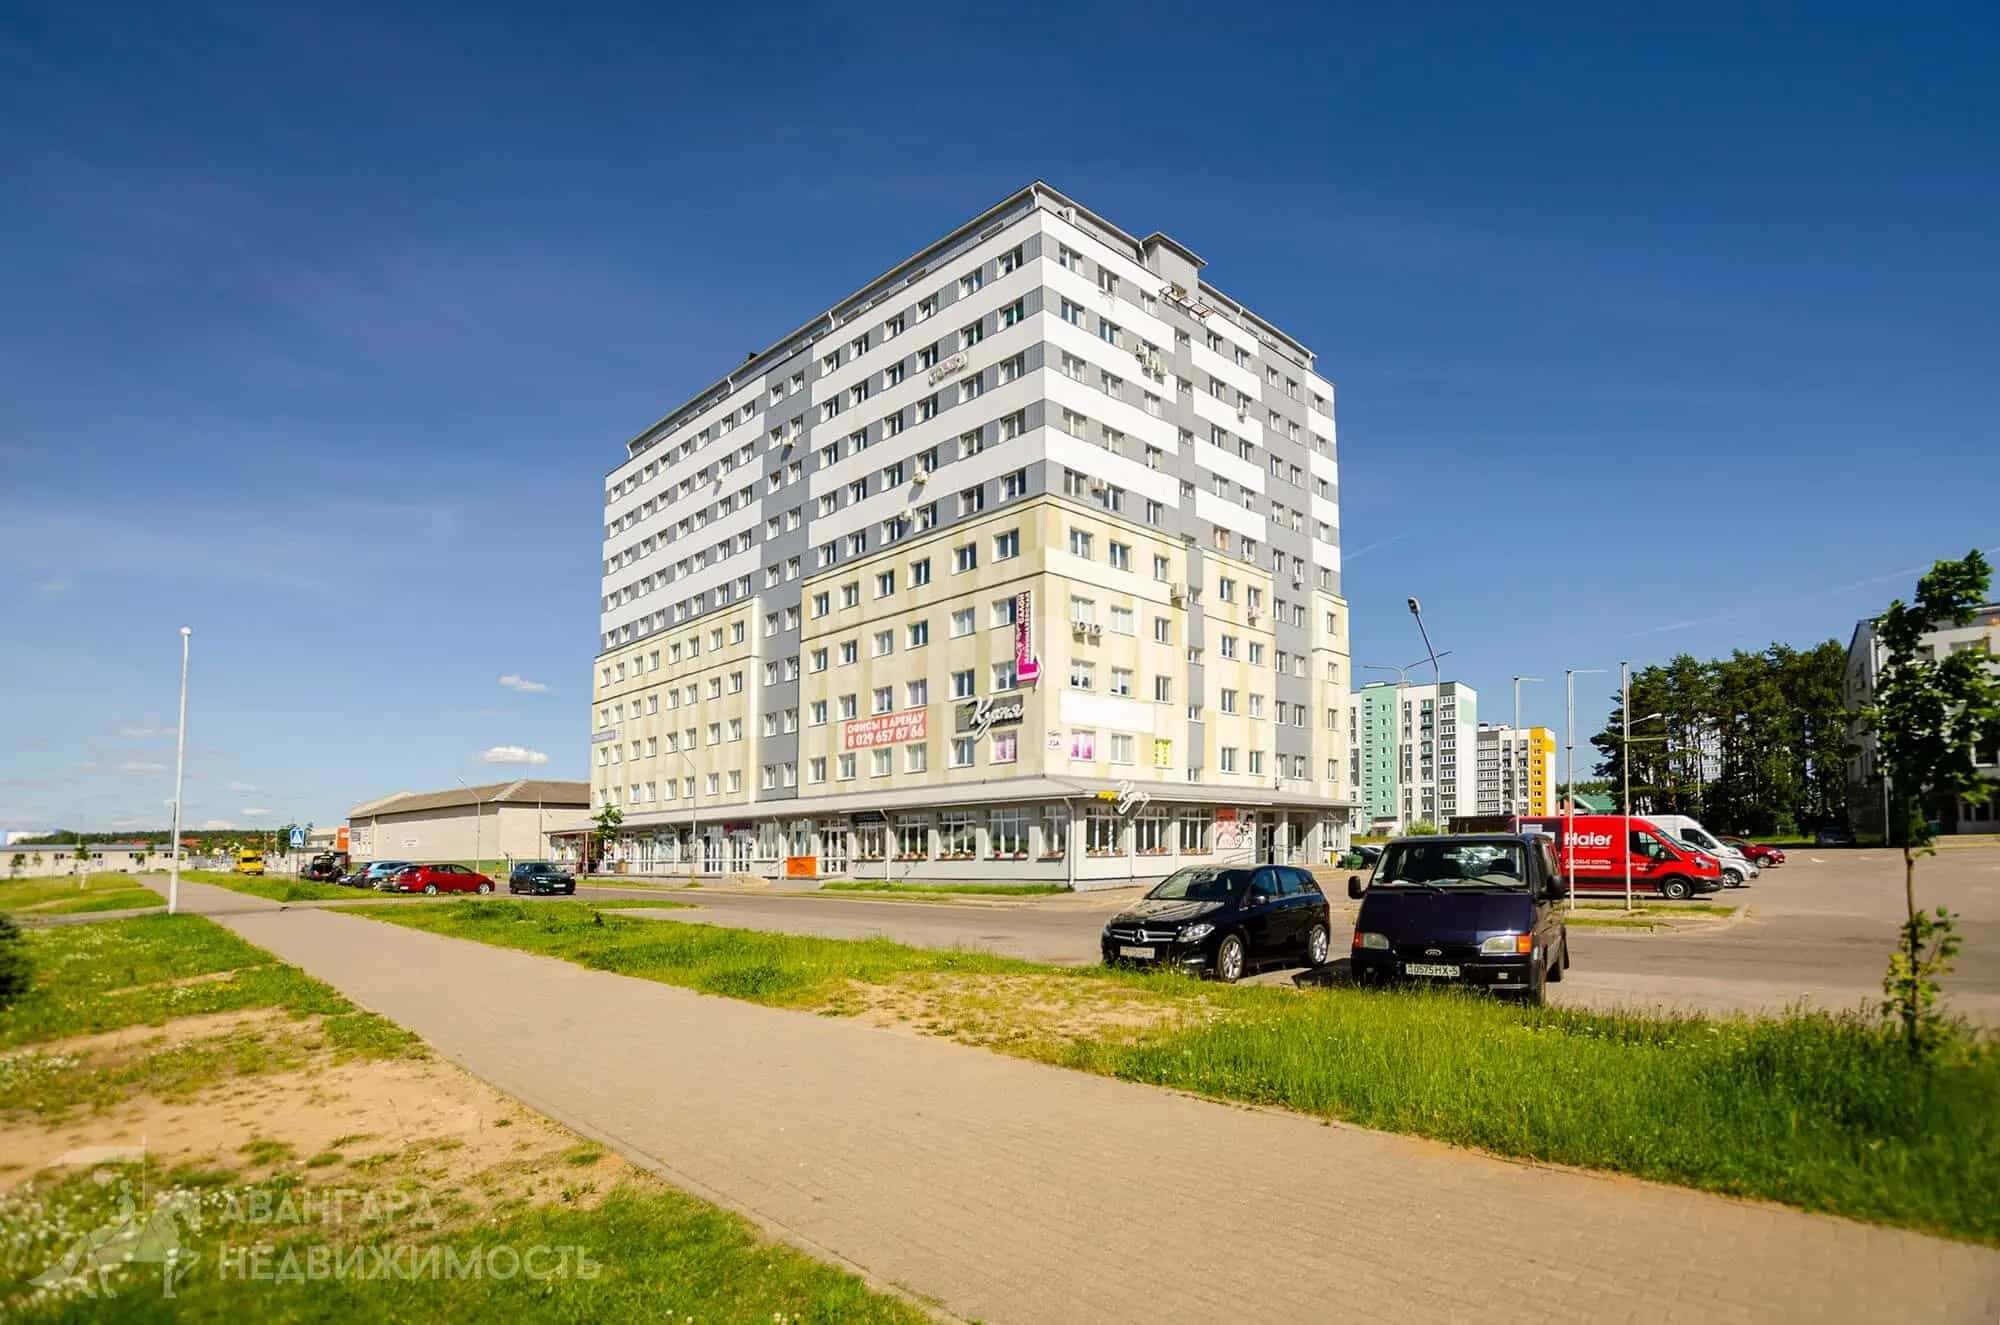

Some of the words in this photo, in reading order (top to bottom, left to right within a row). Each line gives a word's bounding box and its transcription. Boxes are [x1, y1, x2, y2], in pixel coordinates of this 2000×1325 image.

[847, 719, 880, 734] ОФИСЫ
[889, 711, 924, 728] АРЕНДУ
[847, 735, 854, 747] 8
[855, 732, 874, 746] 029
[876, 729, 894, 743] 657
[895, 726, 909, 740] 87
[910, 724, 925, 738] 66
[1564, 831, 1612, 846] Haier
